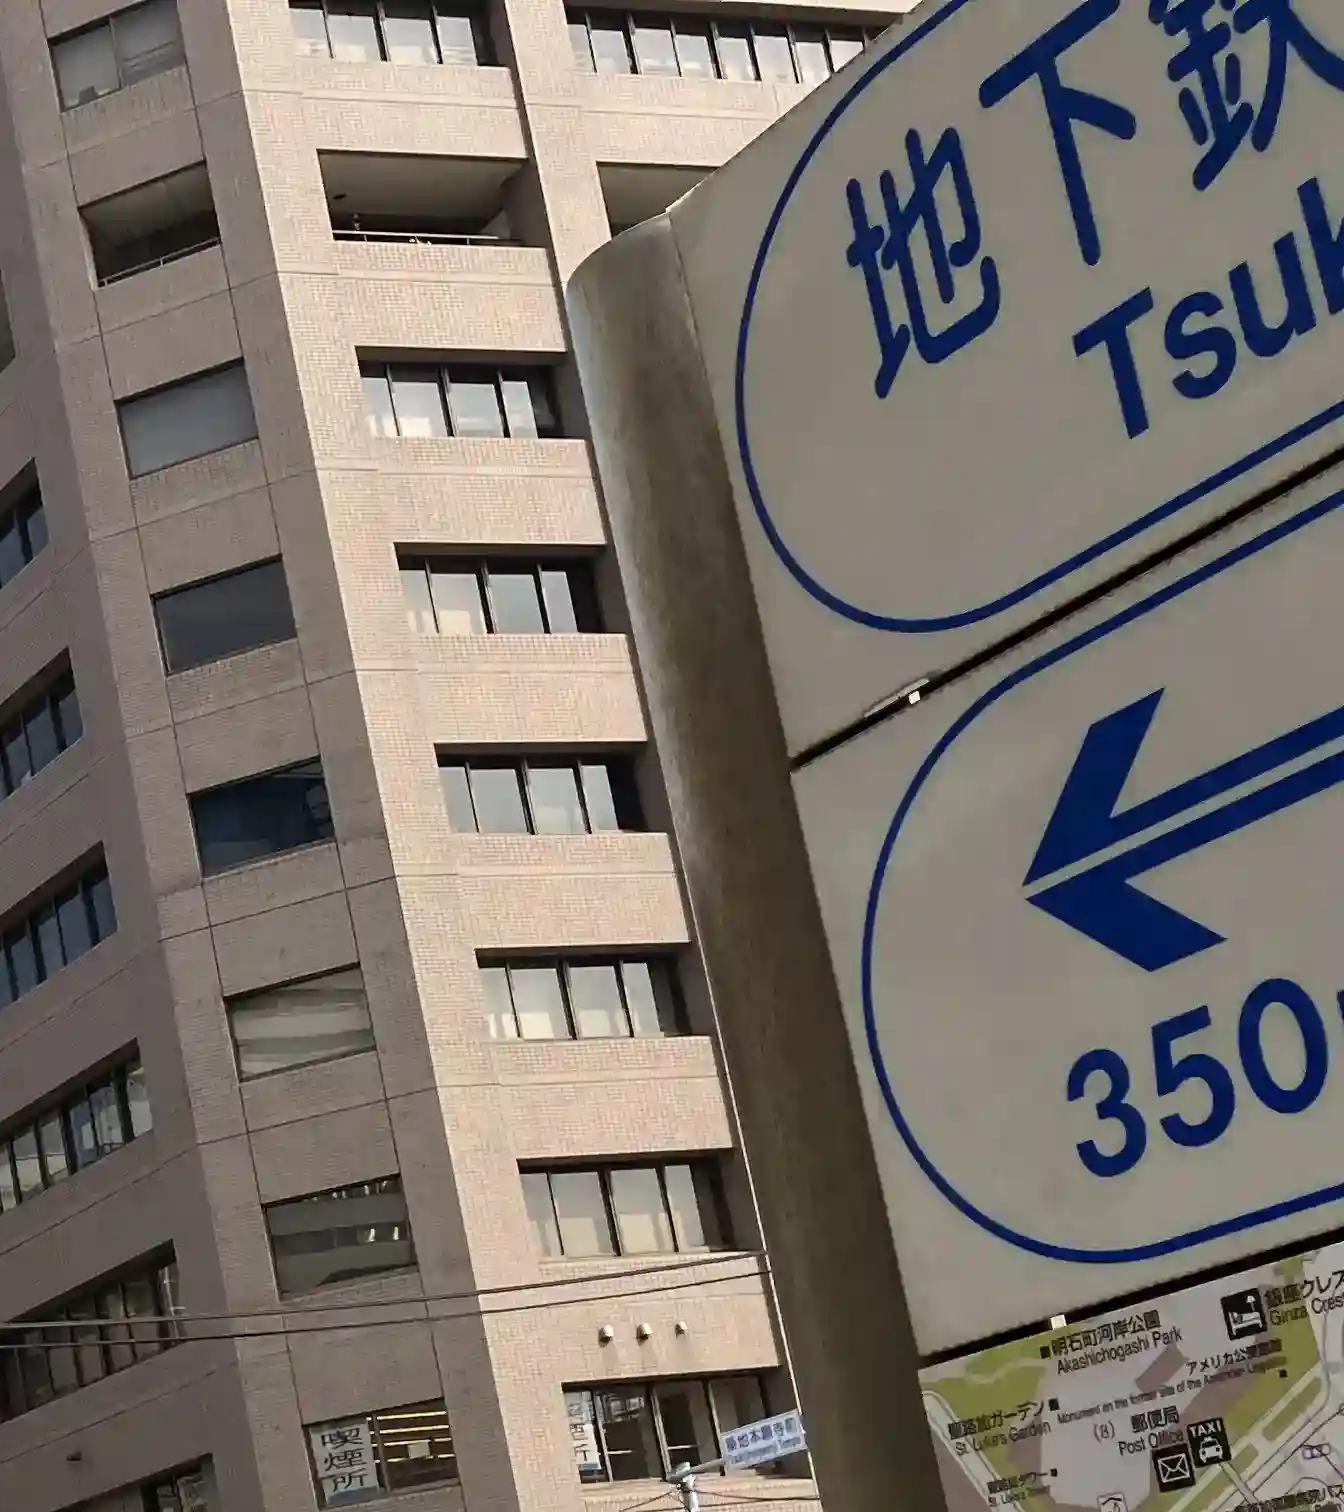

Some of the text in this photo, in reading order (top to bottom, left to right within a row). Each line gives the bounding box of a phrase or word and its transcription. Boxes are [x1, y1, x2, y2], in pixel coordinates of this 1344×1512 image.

[1067, 978, 1344, 1178] 350
[1151, 1326, 1183, 1349] Park
[1009, 1421, 1052, 1442] Garden
[1189, 1420, 1223, 1438] TAXI
[1118, 1436, 1147, 1457] Post
[320, 1427, 367, 1493] 喫煙所
